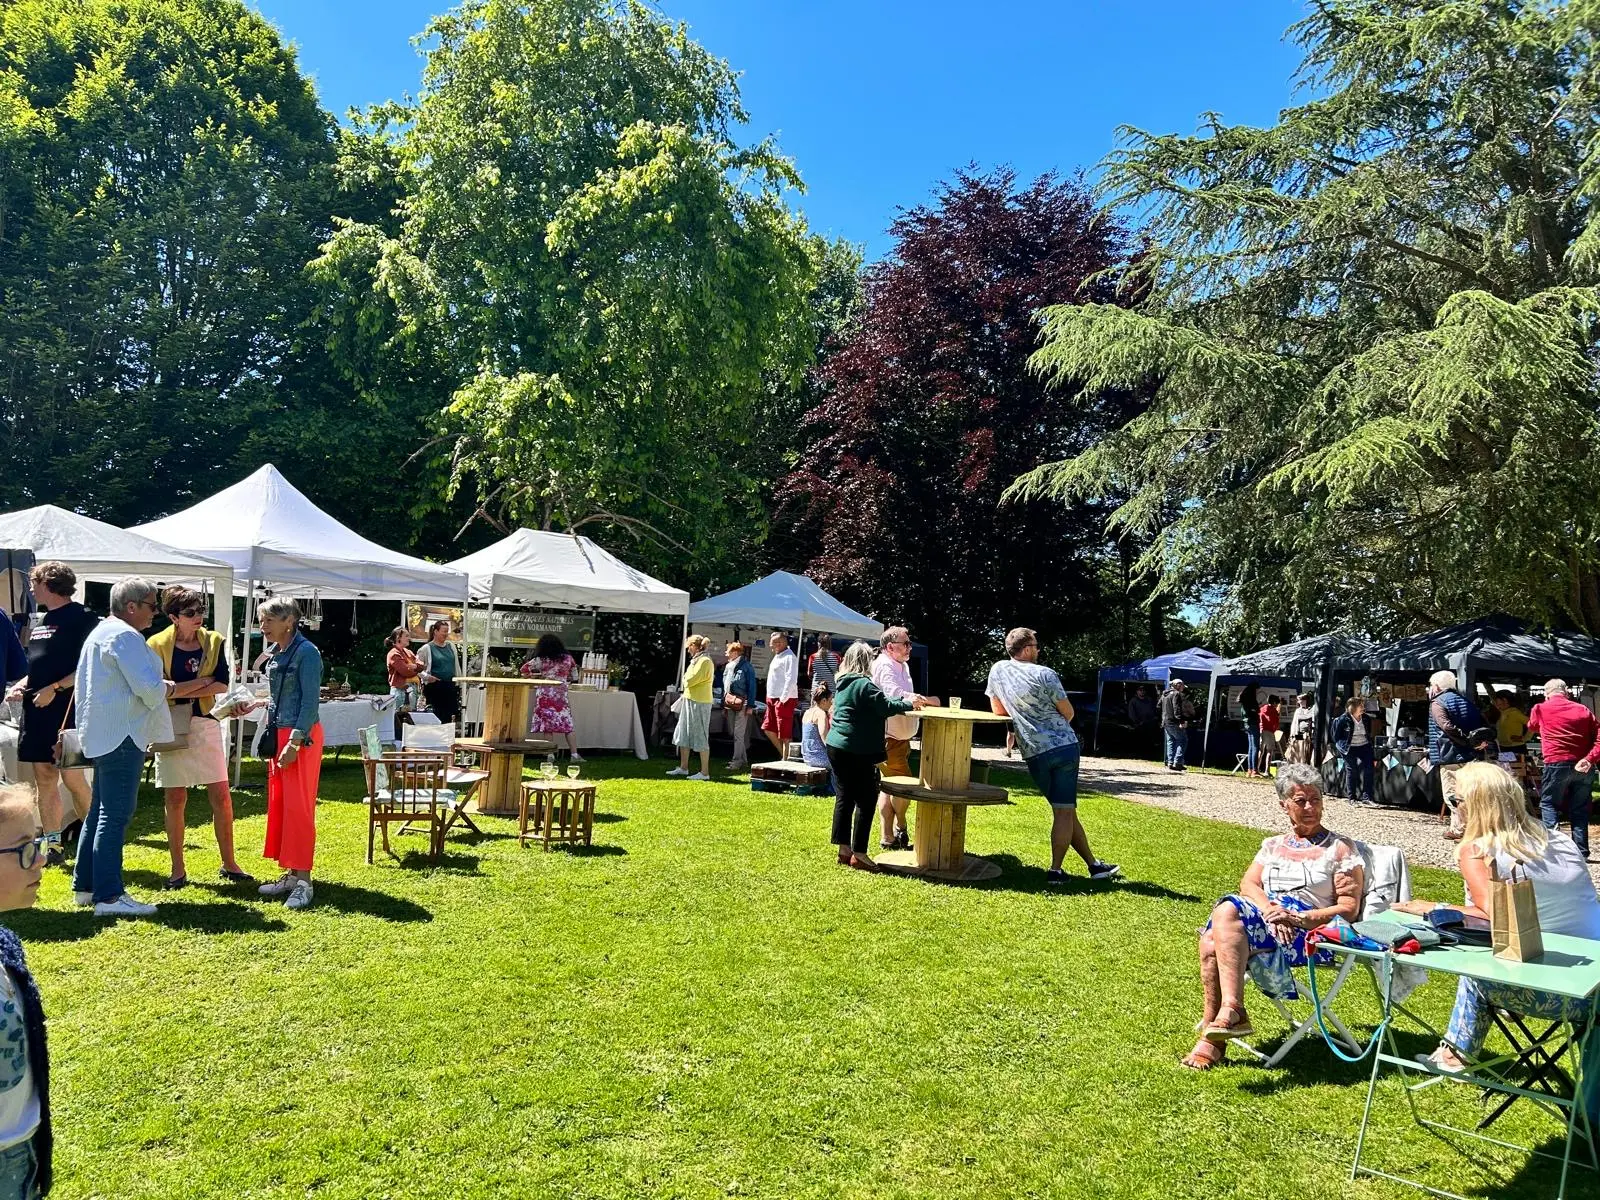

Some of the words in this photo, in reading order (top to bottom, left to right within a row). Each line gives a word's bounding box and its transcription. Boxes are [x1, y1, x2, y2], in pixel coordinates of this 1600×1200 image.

[472, 611, 504, 620] PRODITS
[517, 623, 526, 631] EN
[527, 624, 563, 633] NORMANDIE
